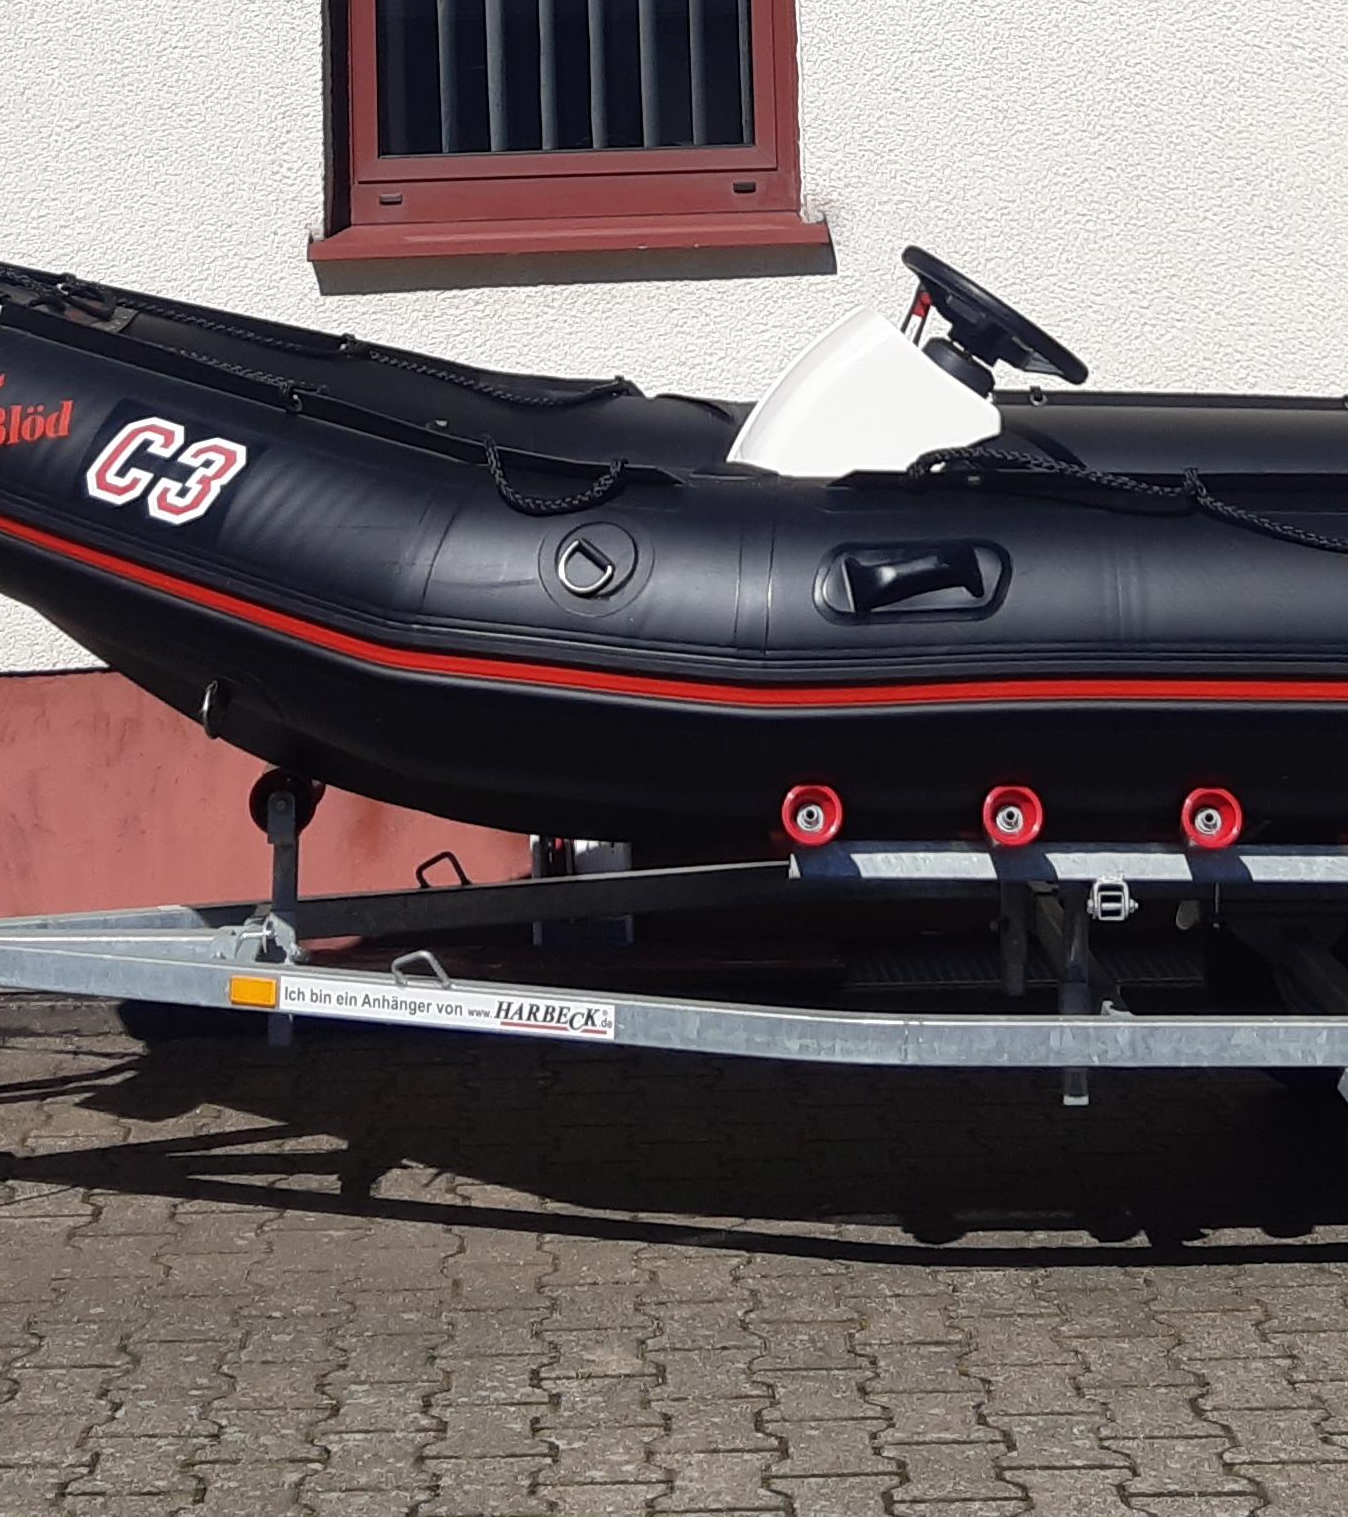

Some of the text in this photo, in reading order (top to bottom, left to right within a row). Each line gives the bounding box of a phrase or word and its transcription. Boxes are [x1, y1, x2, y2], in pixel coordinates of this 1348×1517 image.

[85, 416, 247, 525] C3
[284, 985, 306, 1002] Ich
[309, 988, 332, 1005] bin
[336, 991, 358, 1007] ein
[360, 993, 433, 1015] Anhänger
[435, 1002, 463, 1016] von
